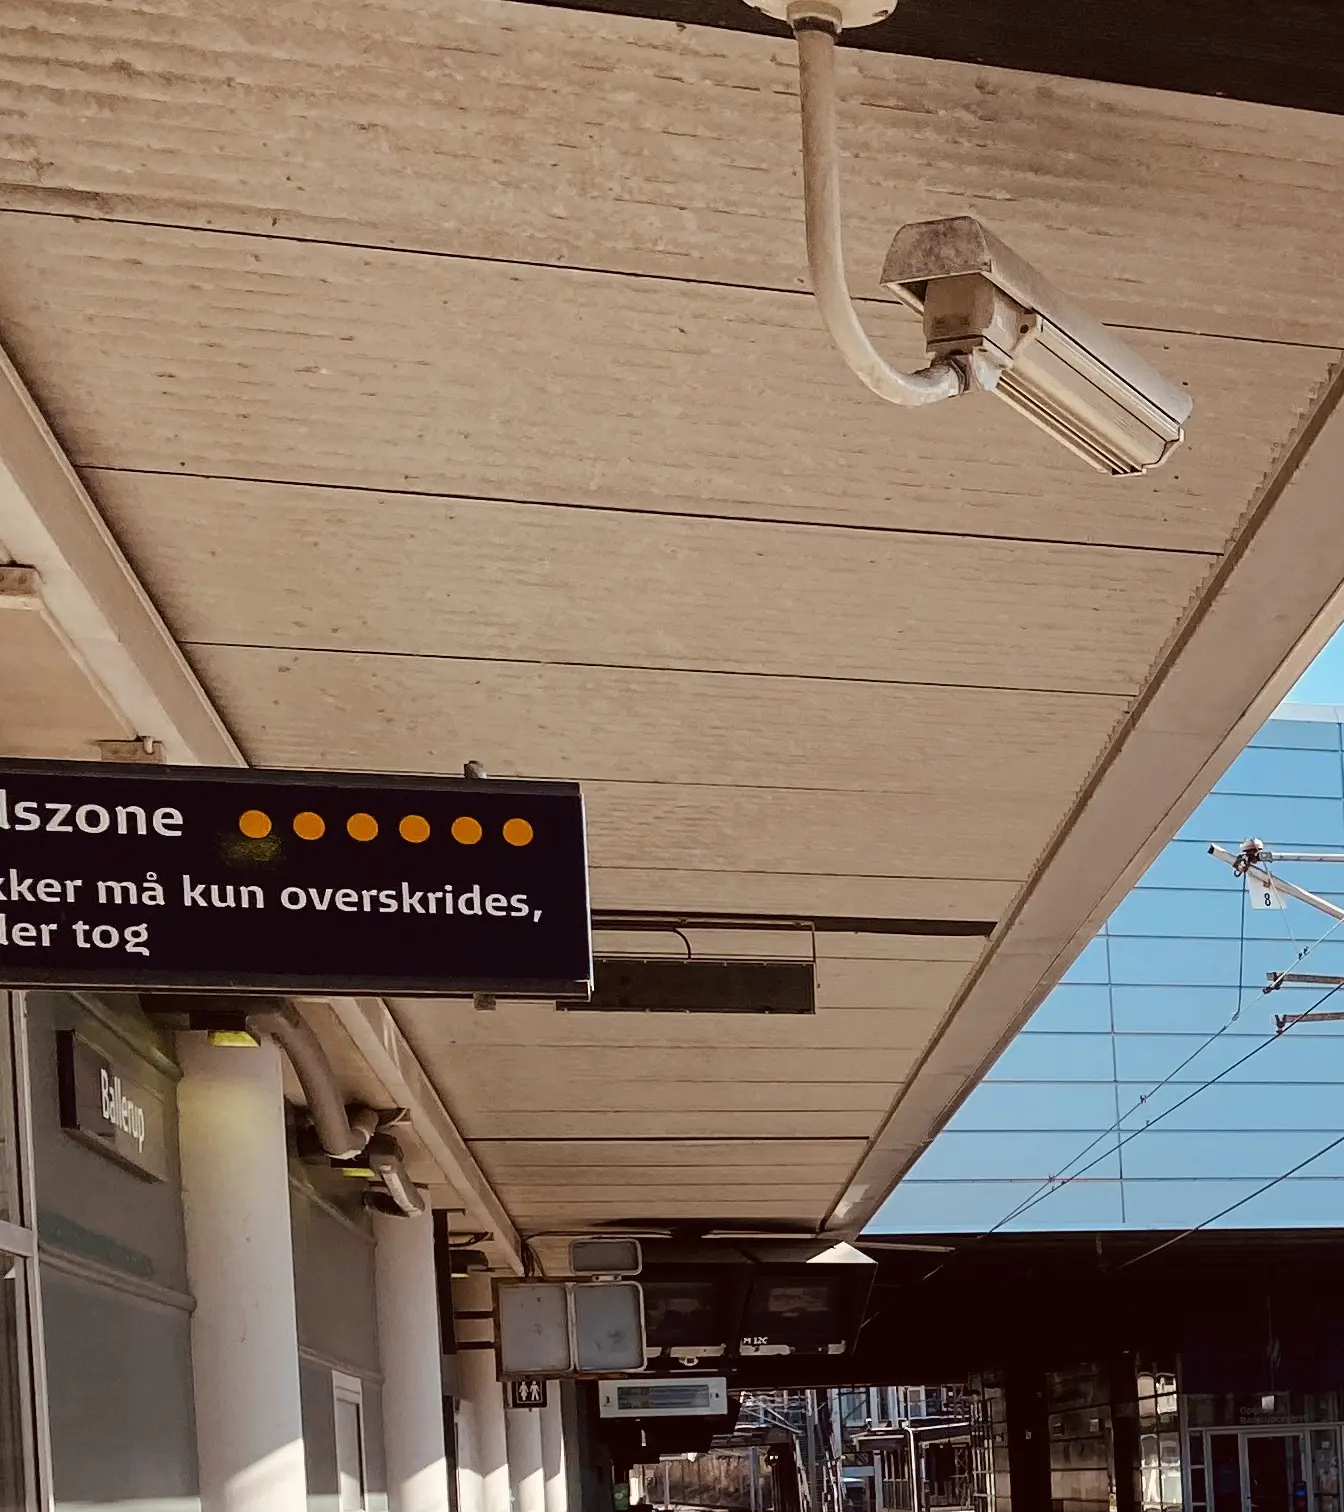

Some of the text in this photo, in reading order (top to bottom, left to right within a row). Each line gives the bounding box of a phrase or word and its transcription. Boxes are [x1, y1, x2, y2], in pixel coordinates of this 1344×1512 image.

[0, 868, 542, 922] ker må kun overskrides,
[1264, 893, 1271, 906] 8
[72, 920, 150, 957] tog
[100, 1068, 144, 1154] Ballerup
